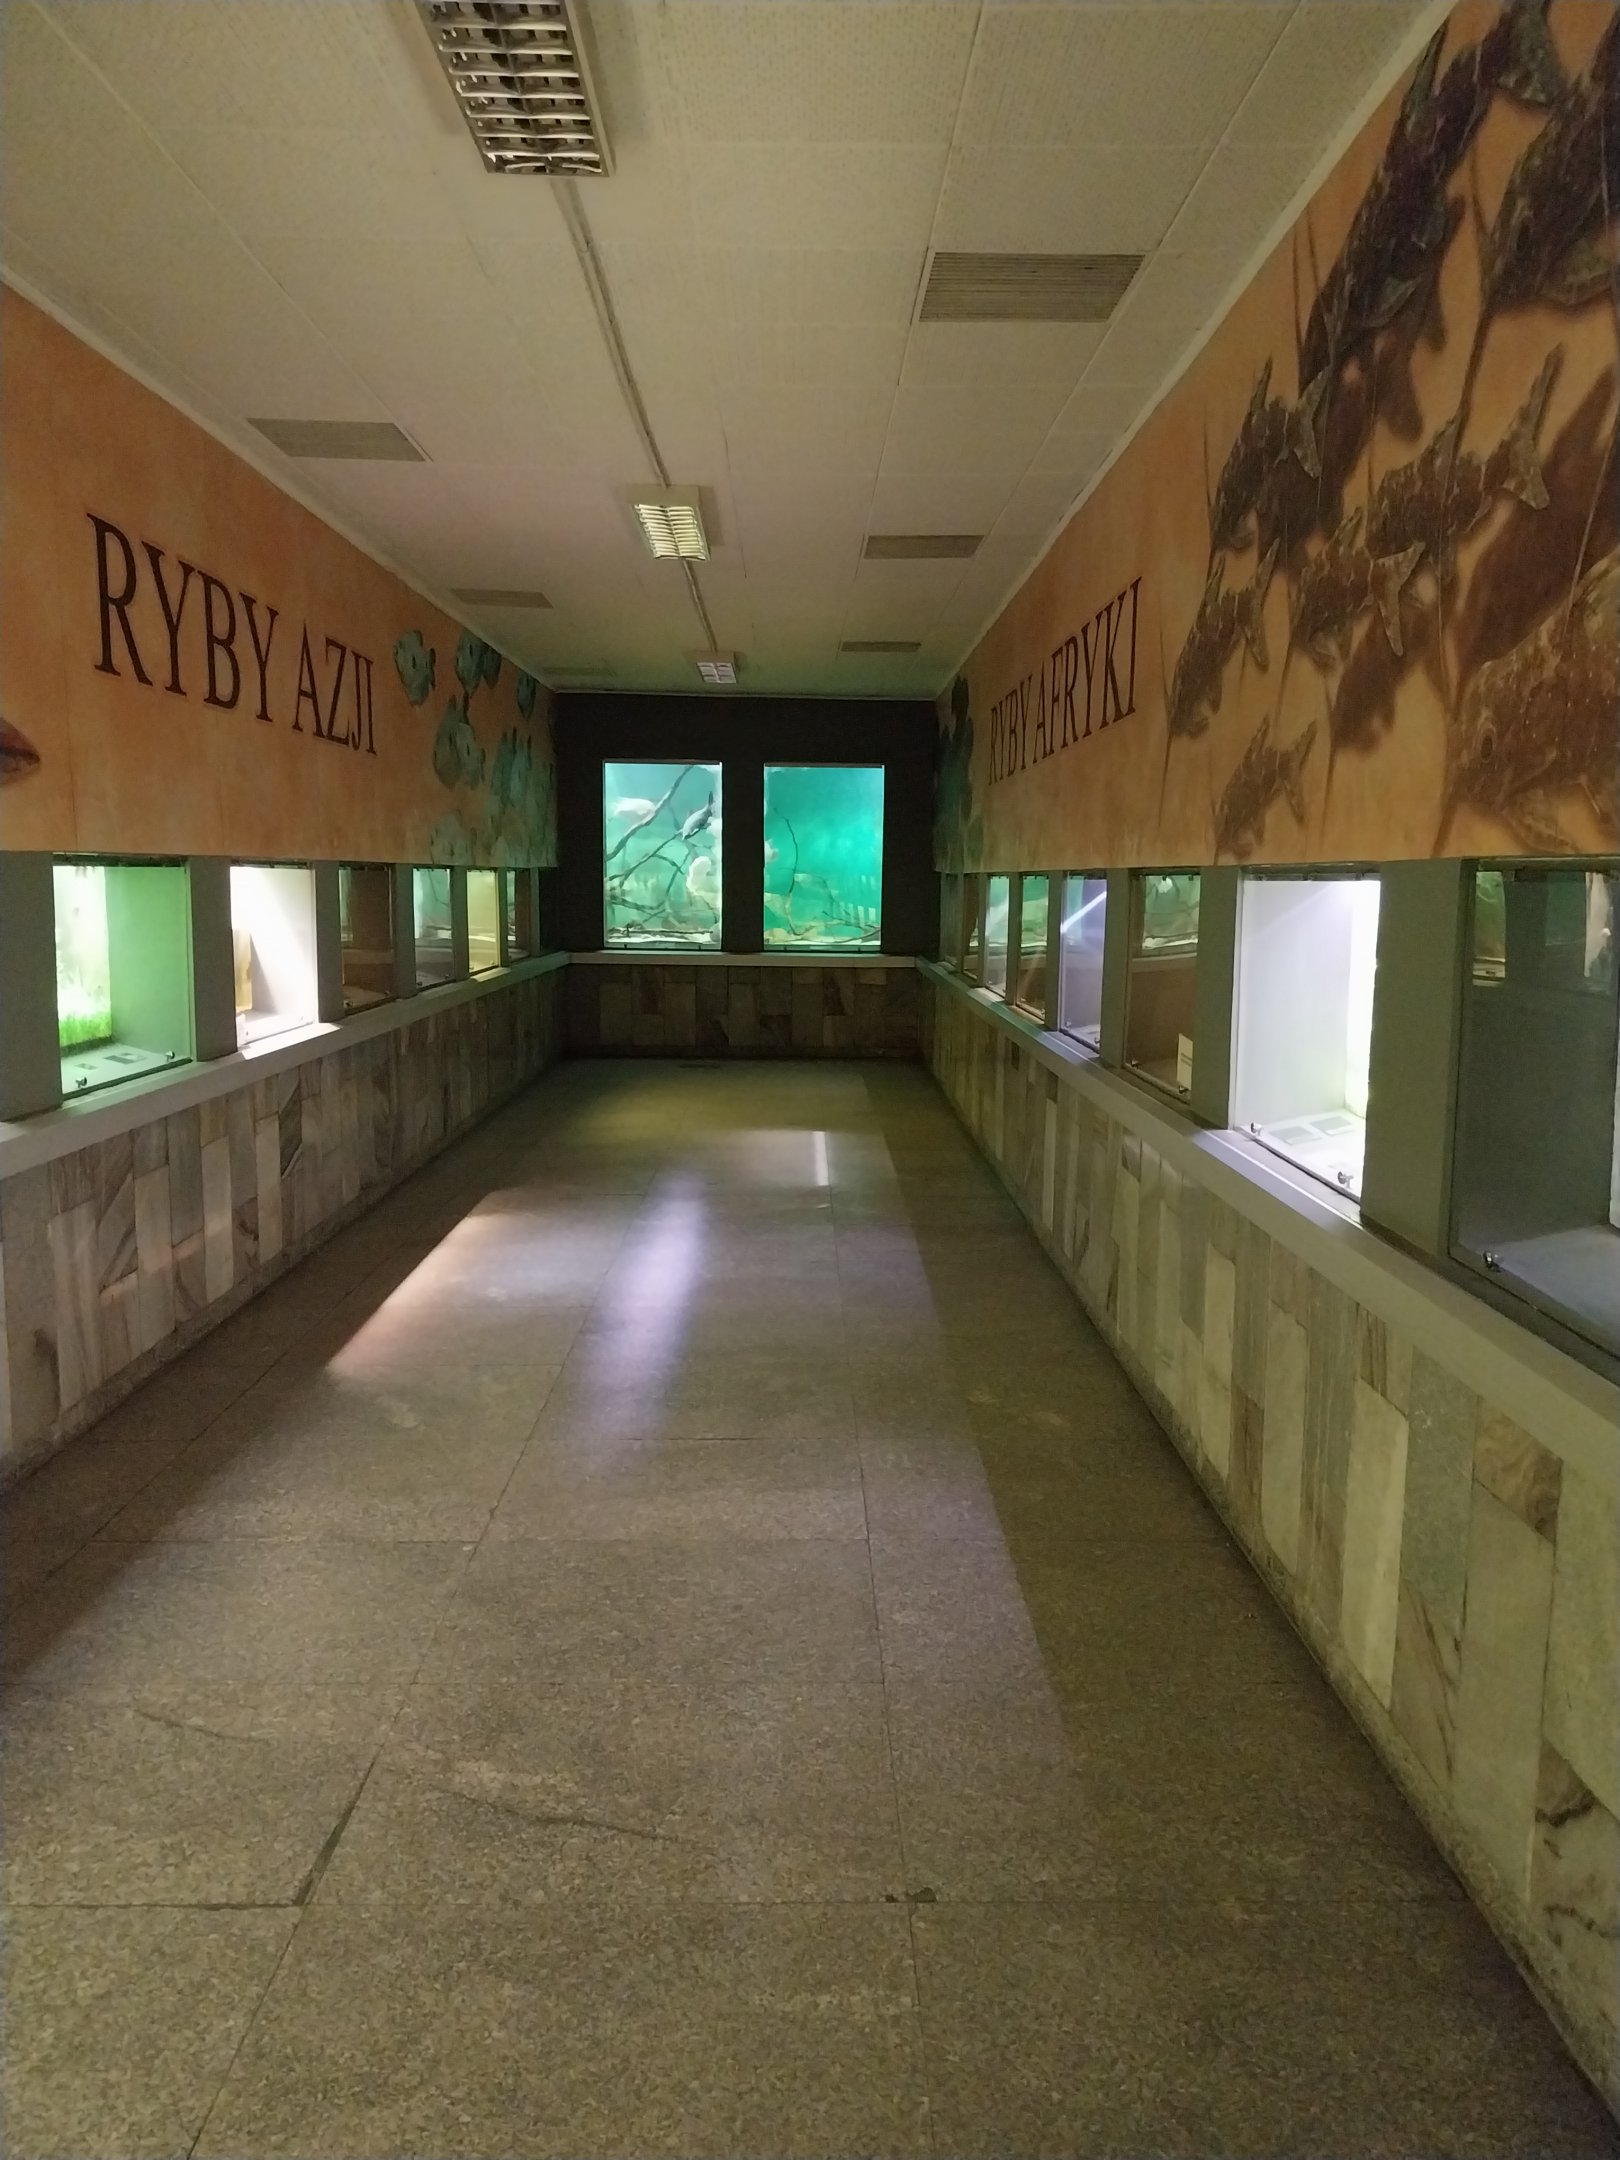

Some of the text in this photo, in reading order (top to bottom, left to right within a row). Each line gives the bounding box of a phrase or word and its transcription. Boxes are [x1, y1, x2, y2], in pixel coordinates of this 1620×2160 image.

[86, 512, 377, 755] RYBY AZJI
[989, 576, 1142, 785] RYBY AFRYKI
